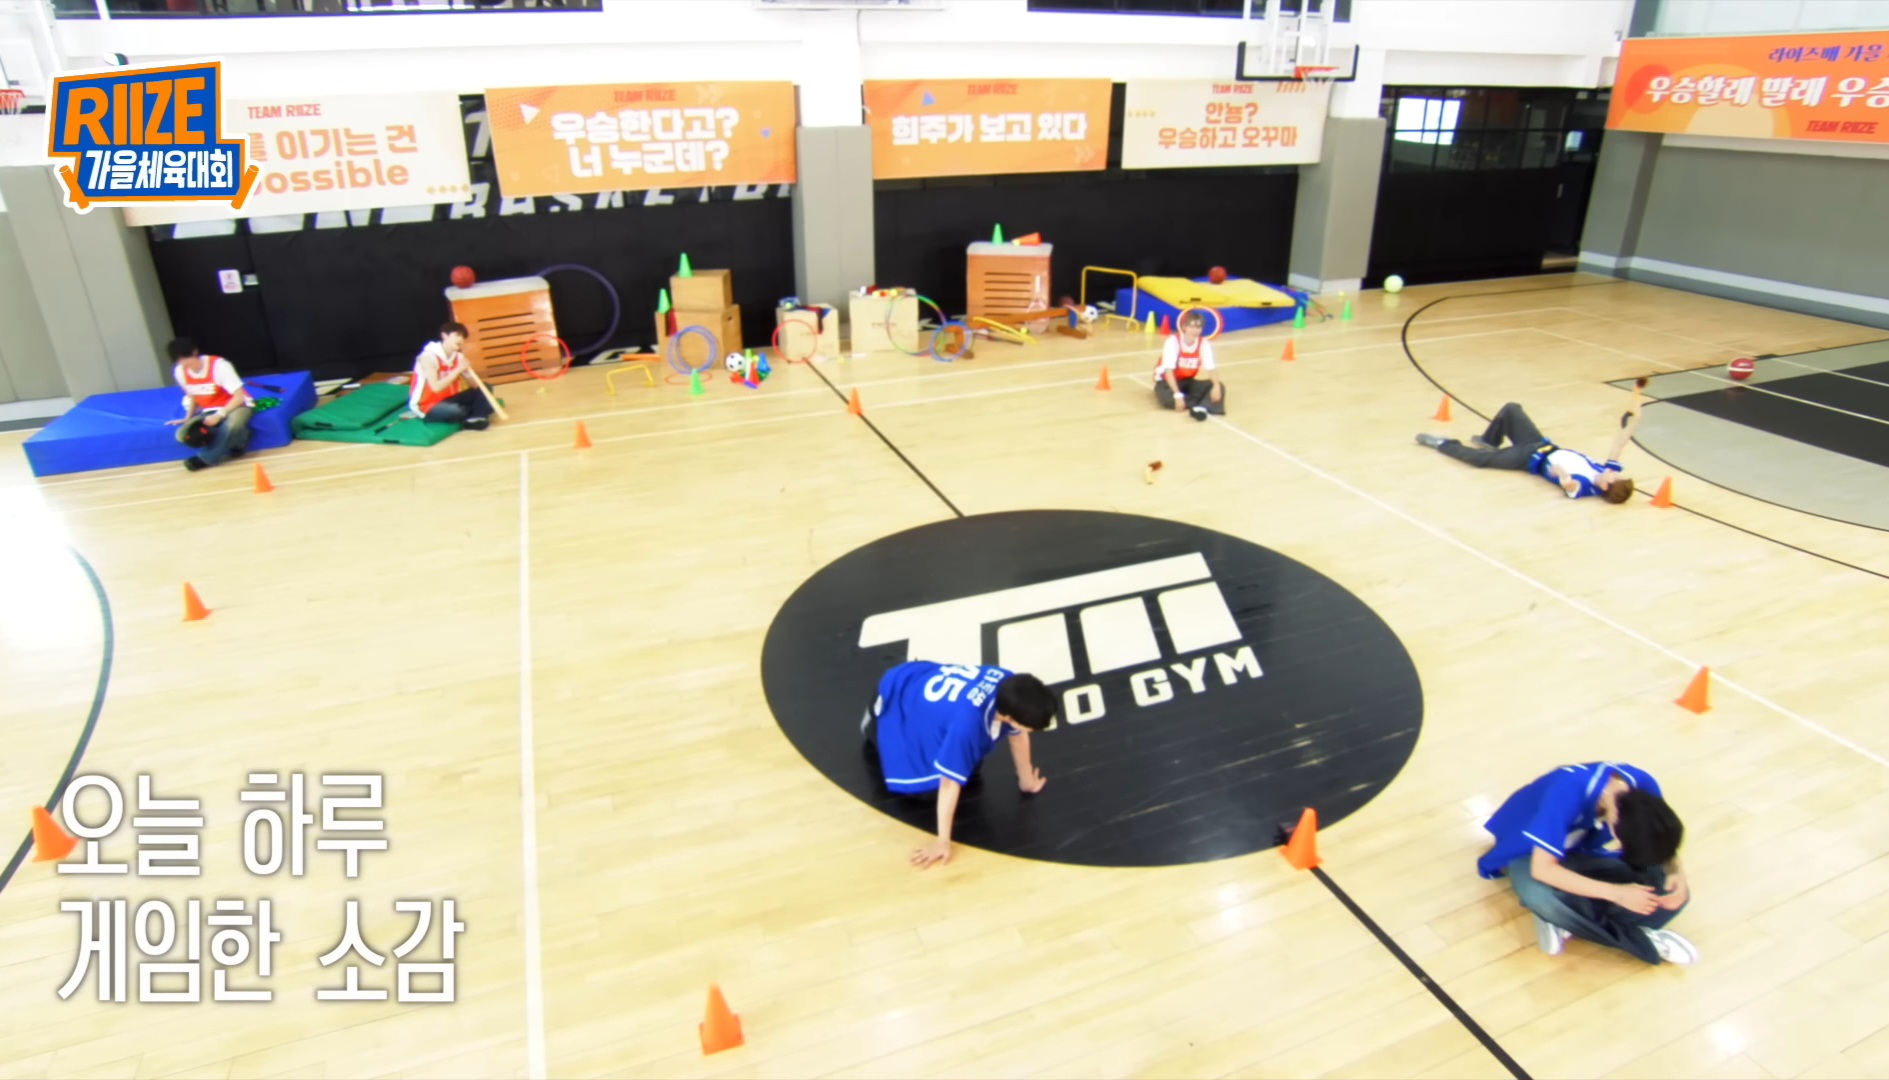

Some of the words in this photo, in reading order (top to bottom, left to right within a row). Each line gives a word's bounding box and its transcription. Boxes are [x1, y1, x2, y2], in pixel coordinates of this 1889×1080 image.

[1768, 45, 1842, 63] 라이즈배
[1646, 75, 1758, 107] 우승할래
[1759, 75, 1829, 108] 말래
[248, 106, 282, 119] TEAM
[551, 107, 740, 145] 우승한다고?
[892, 113, 975, 146] 희주가
[979, 113, 1032, 143] 보고
[1037, 111, 1088, 142] 있다
[1806, 120, 1840, 133] TEAM
[276, 127, 378, 160] 이기는
[385, 124, 418, 153] 건
[1158, 127, 1237, 149] 우승하고
[1242, 126, 1297, 148] 오꾸마
[568, 144, 604, 178] 너
[608, 139, 730, 175] 누군데?
[252, 158, 410, 197] ossible
[1130, 646, 1264, 707] GYM
